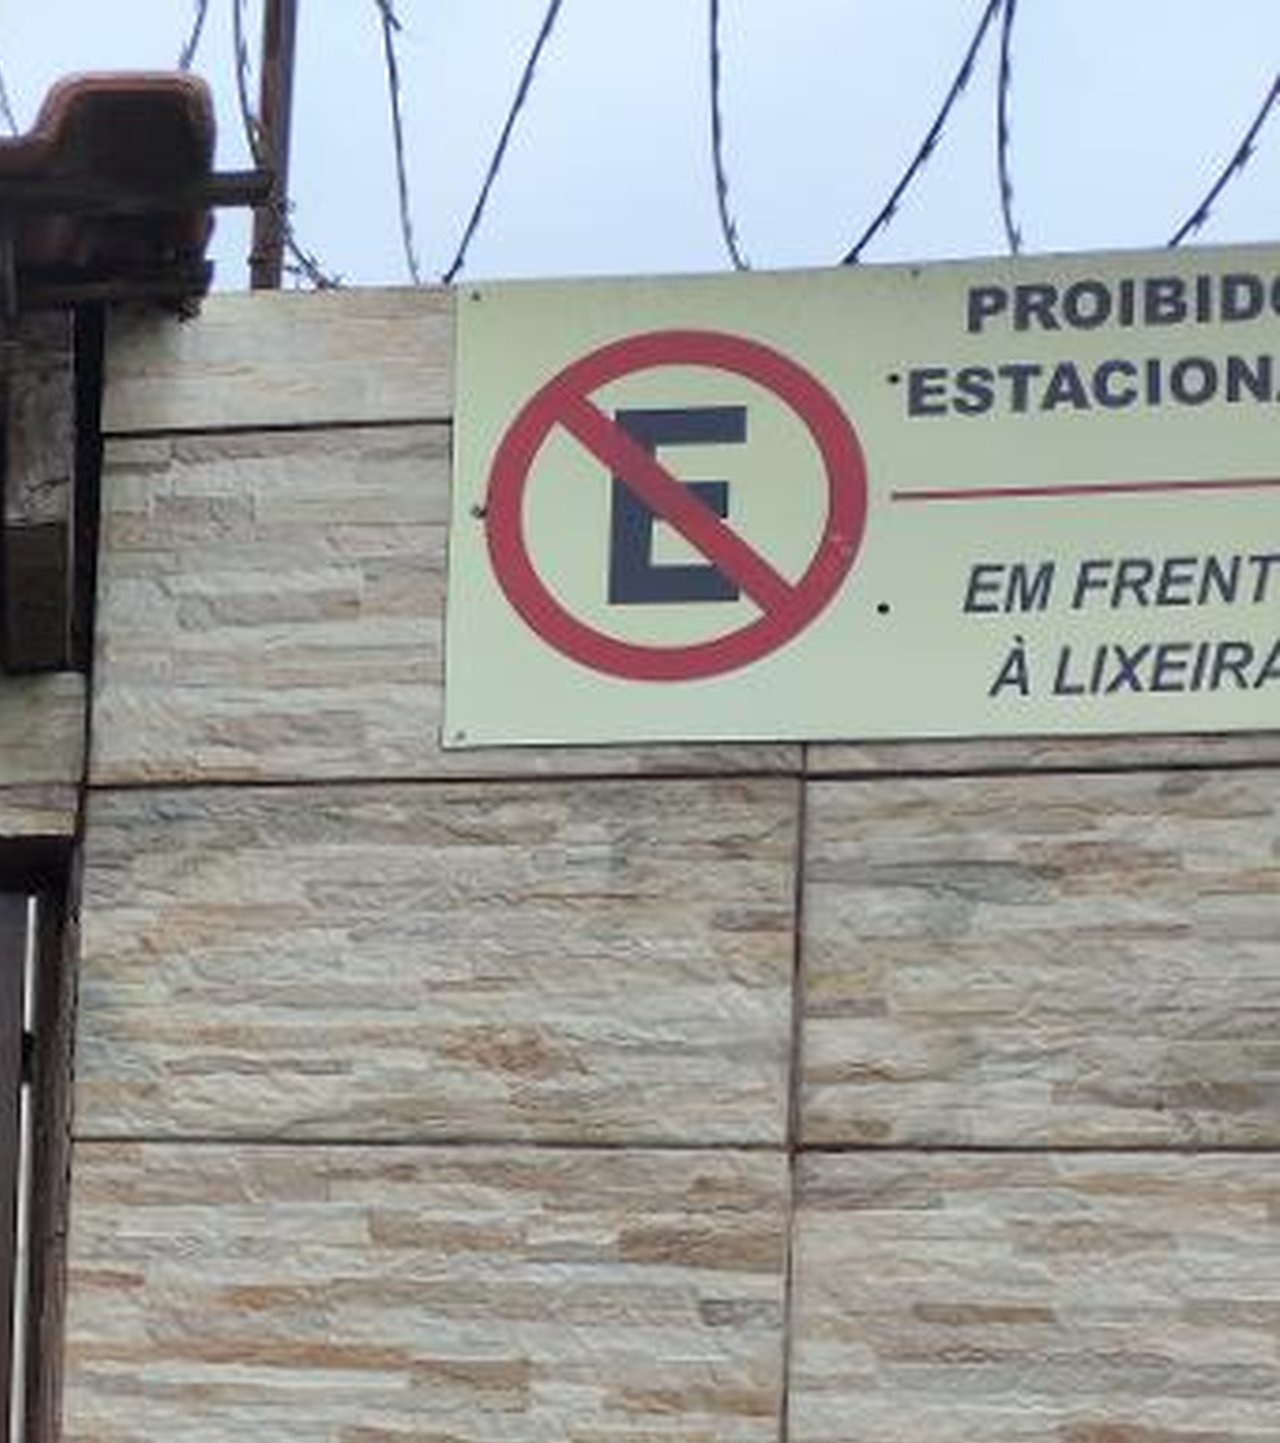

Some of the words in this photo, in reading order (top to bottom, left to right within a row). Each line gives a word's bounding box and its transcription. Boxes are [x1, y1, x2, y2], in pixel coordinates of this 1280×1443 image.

[966, 272, 1280, 335] PROIBID
[907, 354, 1280, 417] ESTACION
[963, 560, 1056, 614] EM
[988, 634, 1030, 697] À
